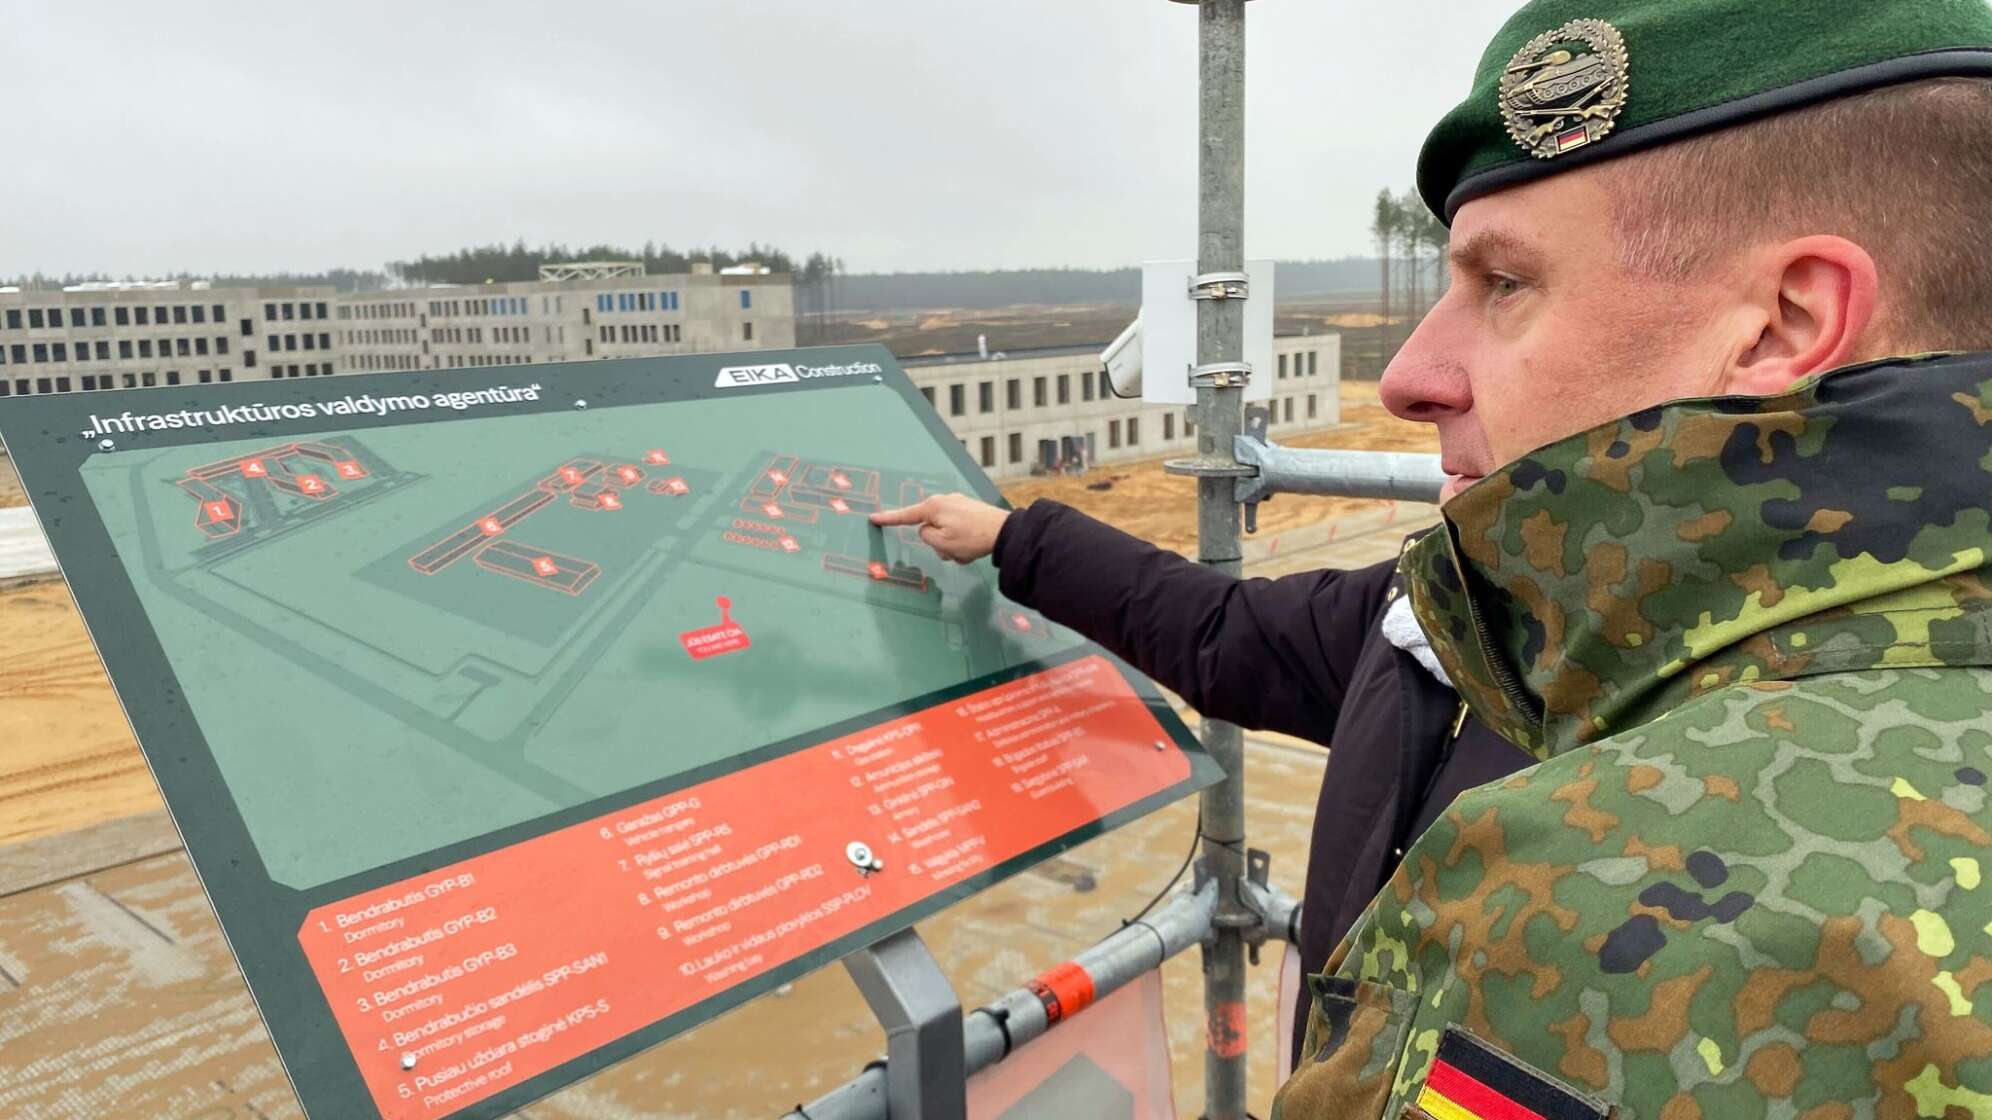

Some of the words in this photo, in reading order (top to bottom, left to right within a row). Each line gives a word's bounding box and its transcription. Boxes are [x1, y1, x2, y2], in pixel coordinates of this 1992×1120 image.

[729, 367, 793, 383] EIKA
[795, 361, 882, 379] Construction
[316, 394, 430, 416] valdymo
[249, 462, 265, 473] 4
[342, 464, 358, 476] 3
[305, 478, 320, 491] 2
[212, 504, 225, 517] 1
[662, 797, 700, 817] GPP-G
[653, 873, 708, 898] Remonto
[336, 891, 424, 927] Bendrabutis
[424, 873, 474, 897] GYP-B1
[343, 917, 404, 943] Dormitory
[672, 905, 728, 931] Remonto
[337, 958, 353, 973] 2.
[354, 928, 443, 965] Bendrabutis
[443, 907, 496, 934] GYP-B2
[695, 948, 732, 970] Lauko
[740, 929, 776, 949] vidaus
[356, 997, 372, 1012] 3.
[373, 966, 463, 1005] Bendrabutis
[463, 943, 516, 971] GYP-B3
[363, 955, 423, 982] Dormitory
[381, 994, 442, 1022] Dormitory
[393, 1002, 487, 1046] Bendrabučio
[488, 979, 544, 1008] sandėlis
[463, 1015, 505, 1038] storage
[414, 1063, 466, 1090] Pusiau
[467, 1041, 516, 1068] uždara
[517, 1019, 566, 1047] stoginė
[566, 998, 609, 1024] KPS-S
[423, 1075, 487, 1107] Protective
[487, 1060, 512, 1080] roof
